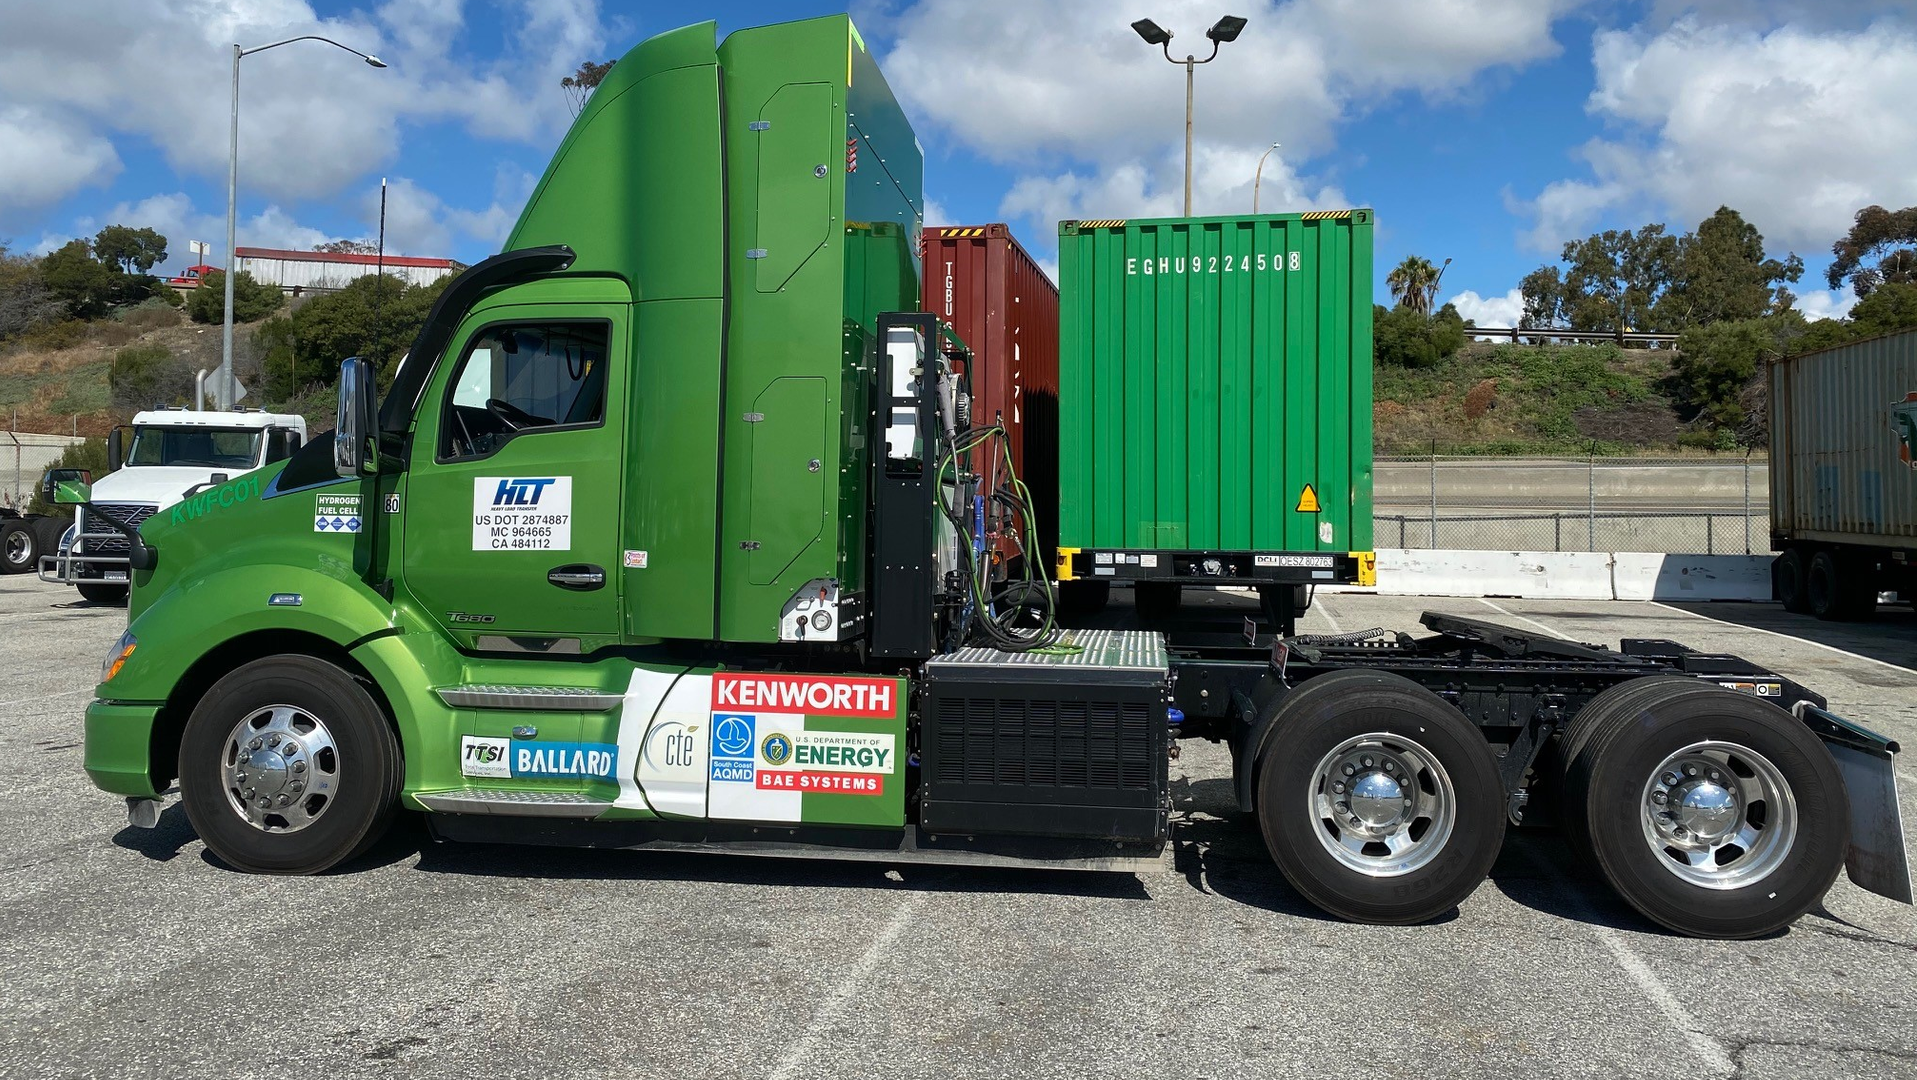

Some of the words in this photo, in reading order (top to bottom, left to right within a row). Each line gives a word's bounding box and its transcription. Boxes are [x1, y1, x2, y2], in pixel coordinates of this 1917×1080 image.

[1127, 251, 1301, 275] EGHU9224508
[945, 261, 953, 316] TGBU
[493, 478, 556, 506] HLT
[318, 496, 361, 505] HYDROGEN
[385, 498, 399, 512] 80
[318, 506, 338, 515] FUEL
[338, 507, 358, 515] CELL
[475, 514, 491, 526] US
[494, 514, 519, 526] DOT
[522, 514, 569, 526] 2874887
[490, 526, 509, 537] MC
[511, 526, 552, 537] 964665
[491, 538, 509, 549] CA
[511, 538, 551, 549] 484112
[446, 611, 496, 624] T680
[717, 679, 890, 711] KENWORTH
[665, 729, 693, 767] cte
[813, 737, 867, 746] DEPARTMENT
[465, 744, 505, 762] TTSI
[795, 744, 890, 768] ENERGY
[518, 748, 612, 777] BALLARD
[713, 760, 732, 768] South
[734, 761, 753, 769] Coast
[713, 767, 753, 781] AQMD
[762, 774, 795, 787] BAE
[800, 775, 877, 791] SYSTEMS
